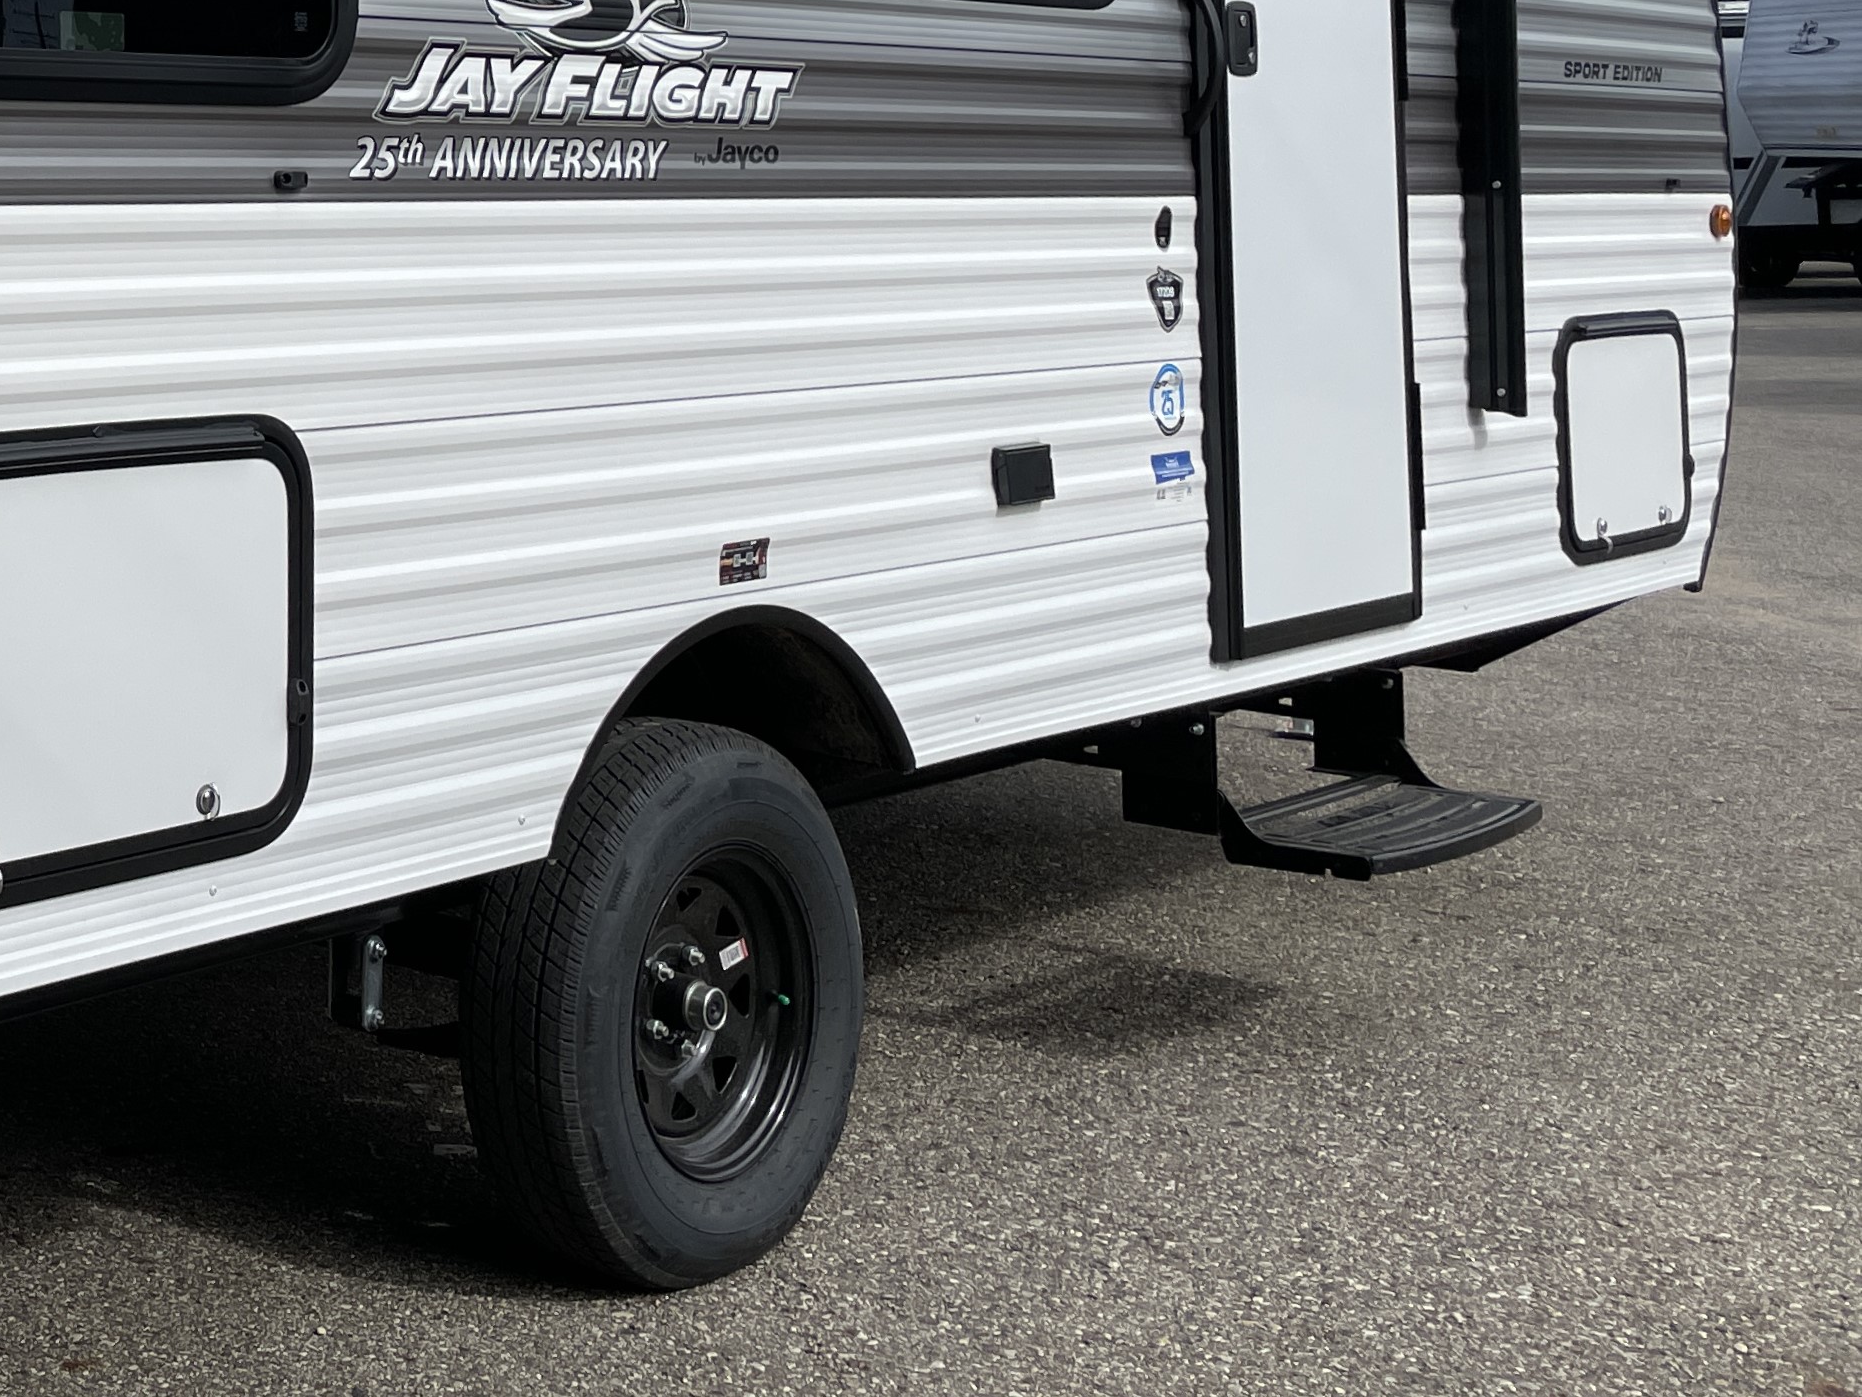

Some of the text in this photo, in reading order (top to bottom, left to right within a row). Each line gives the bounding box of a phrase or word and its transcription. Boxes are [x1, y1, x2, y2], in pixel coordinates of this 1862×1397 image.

[381, 40, 800, 128] JAY FLIGHT
[1563, 61, 1663, 83] SPORT EDITION
[348, 133, 669, 182] 25th ANNIVERSARY
[693, 136, 780, 170] by Jayco
